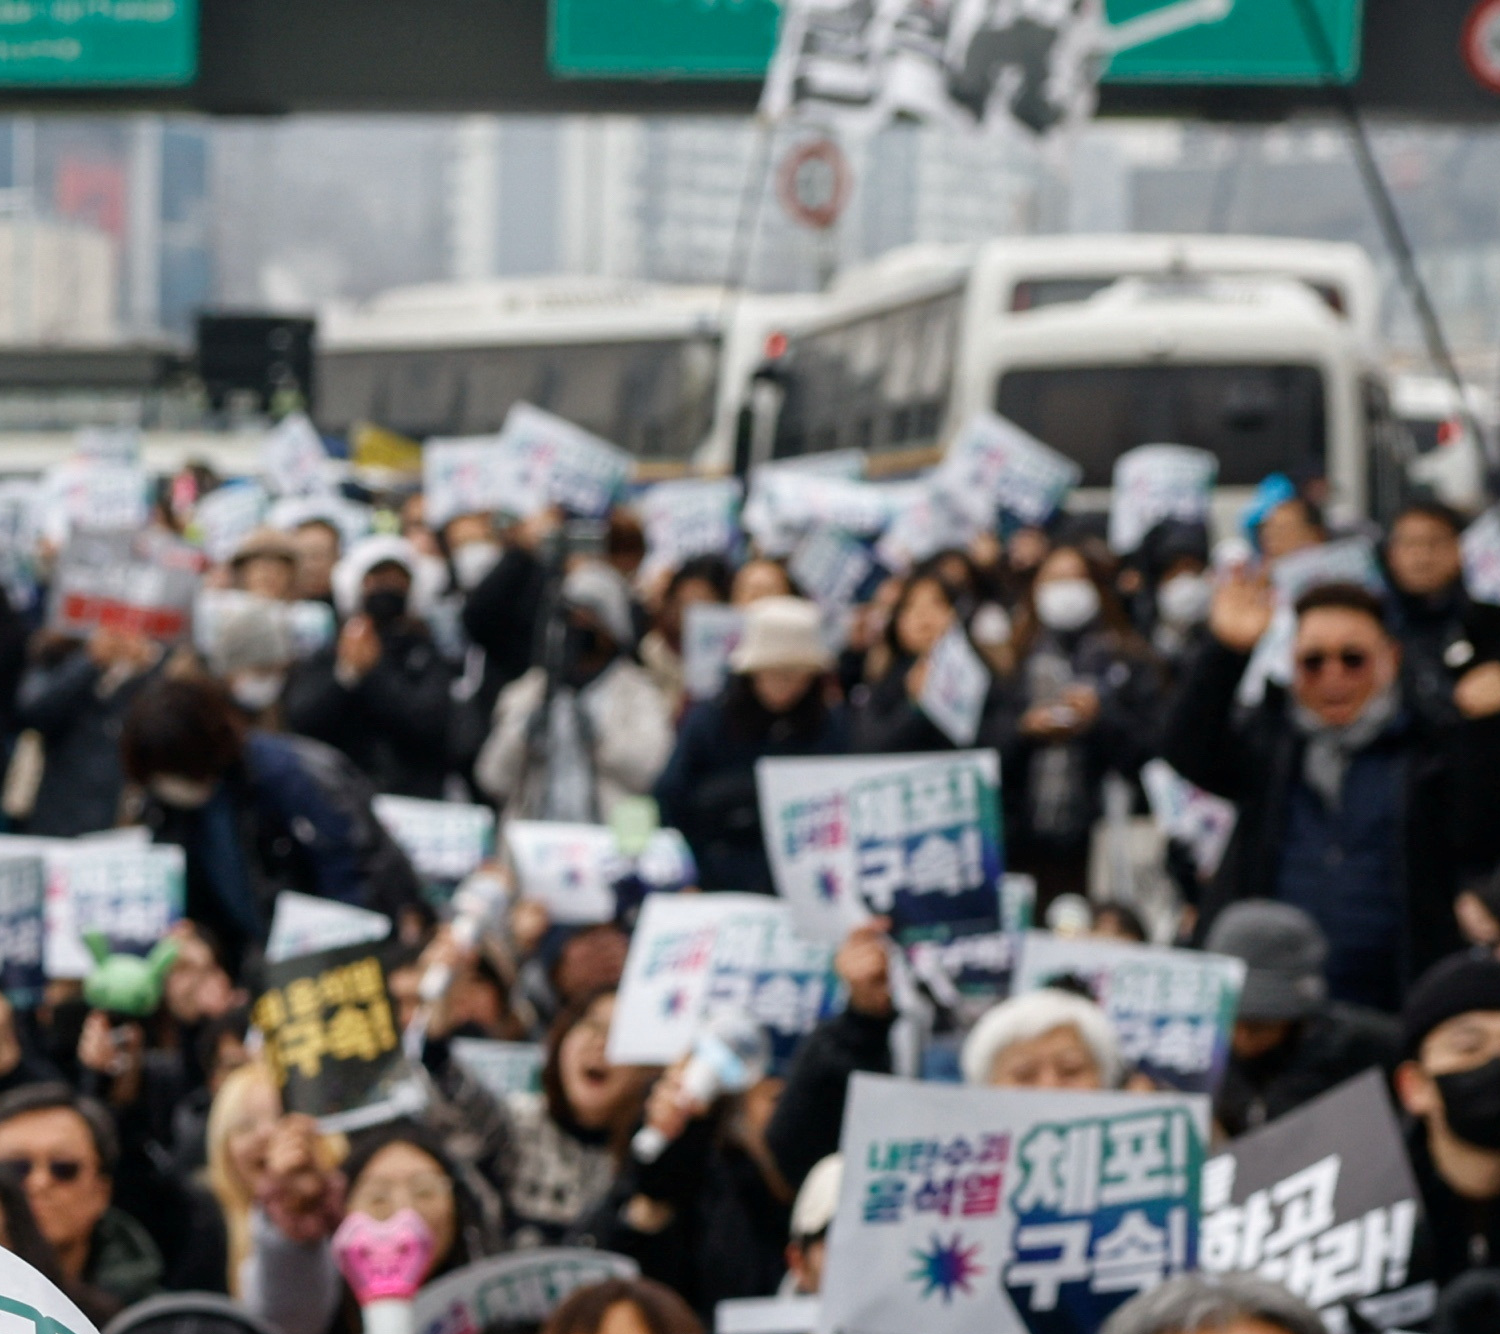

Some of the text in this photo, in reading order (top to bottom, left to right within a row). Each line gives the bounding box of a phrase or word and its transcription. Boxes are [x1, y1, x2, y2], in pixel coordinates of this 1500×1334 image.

[860, 1169, 1003, 1223] 윤석열
[1011, 1107, 1189, 1212] 체포!
[1008, 1206, 1189, 1309] 구속!
